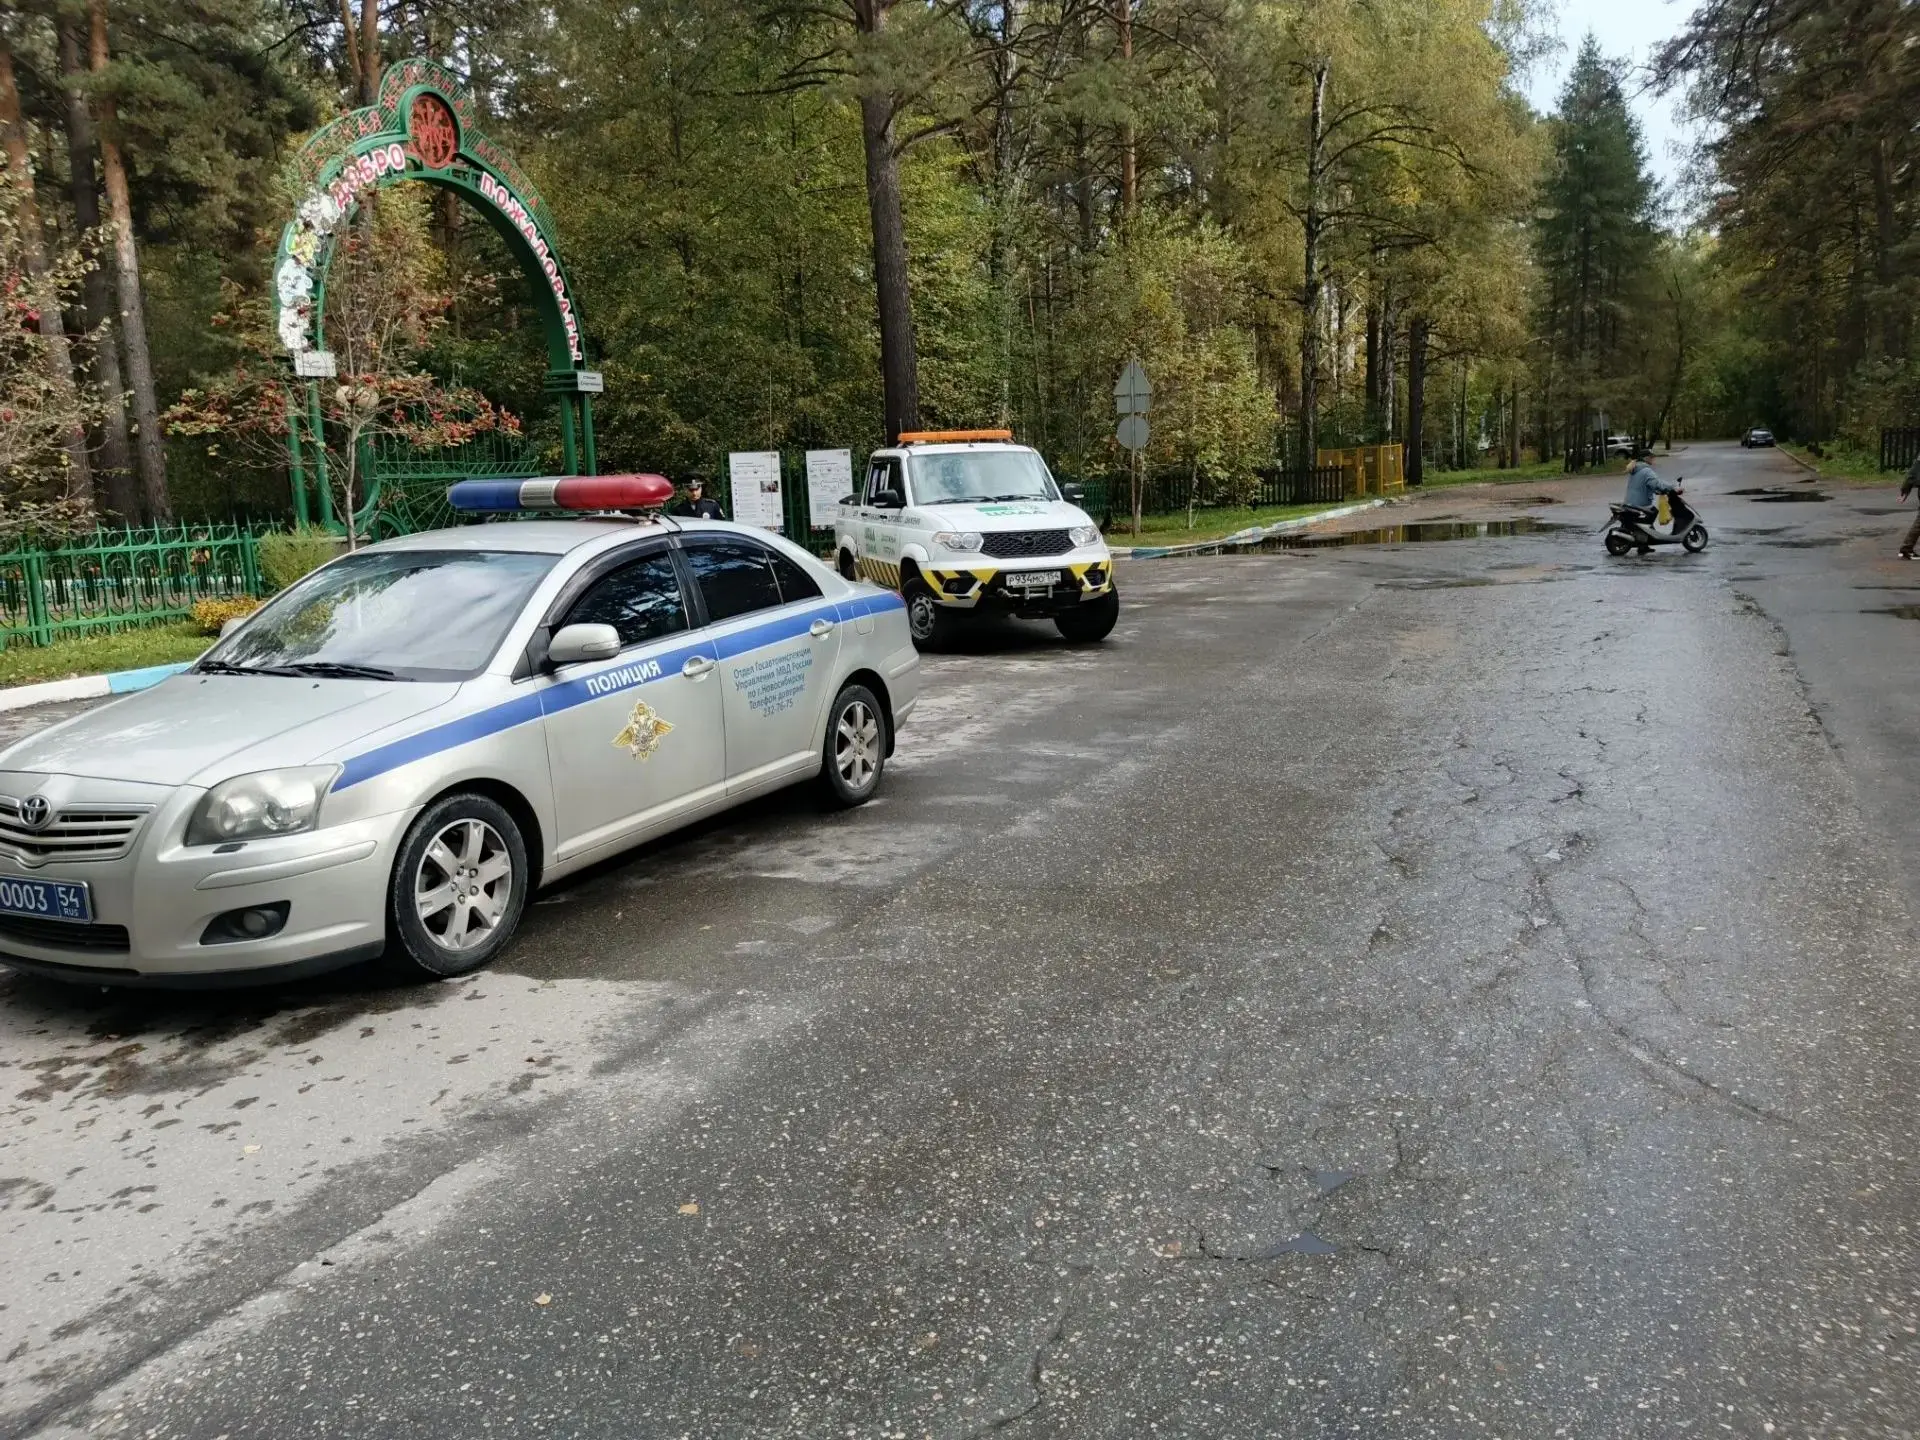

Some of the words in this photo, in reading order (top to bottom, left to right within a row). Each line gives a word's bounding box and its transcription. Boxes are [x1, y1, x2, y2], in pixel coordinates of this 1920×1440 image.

[329, 144, 406, 213] ДОБРО
[480, 171, 583, 361] ПОЖАЛОВАТЬ!
[586, 660, 662, 696] ПОЛИЦИЯ
[776, 664, 792, 676] МВД
[0, 882, 48, 911] 0003
[57, 887, 80, 908] 54
[63, 907, 79, 917] RUS
